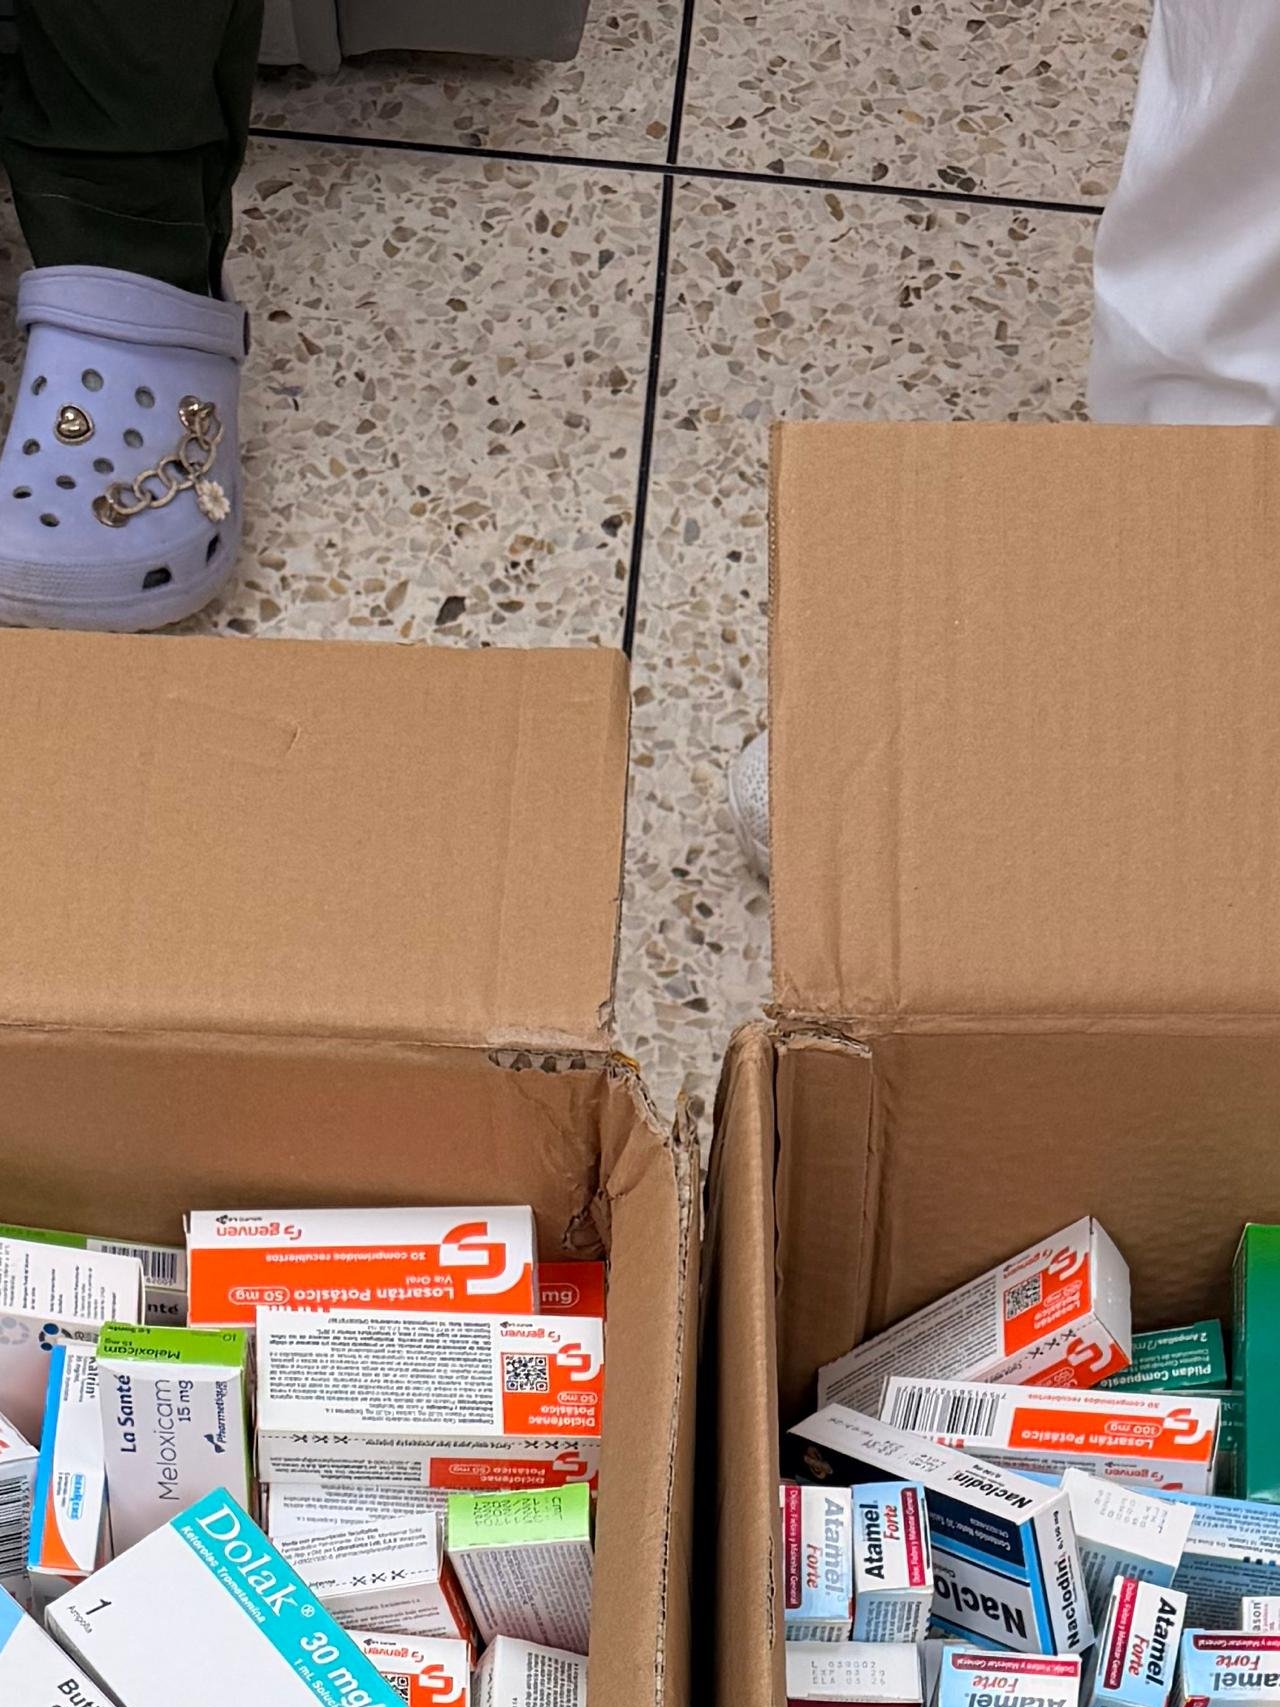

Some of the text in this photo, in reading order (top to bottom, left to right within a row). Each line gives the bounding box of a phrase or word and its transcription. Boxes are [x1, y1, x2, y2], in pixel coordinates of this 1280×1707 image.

[216, 1223, 281, 1237] genven
[235, 1286, 454, 1303] Losartán Potásico 50 mg
[542, 1290, 573, 1305] mg
[1173, 1364, 1212, 1377] Plidan
[178, 1380, 193, 1423] 15 mg
[151, 1379, 179, 1501] Meloxicam
[528, 1416, 596, 1427] Diclofenac
[1021, 1430, 1154, 1449] Losartán Potásico
[945, 1470, 1033, 1510] Naclodin
[859, 1502, 885, 1580] Atamel
[884, 1504, 901, 1541] Forte
[806, 1543, 819, 1589] Forte
[933, 1574, 1028, 1639] Naclo
[1056, 1558, 1080, 1649] Naclodin
[300, 1631, 340, 1666] 30
[1128, 1634, 1150, 1676] Forte
[1149, 1597, 1177, 1687] Atamel
[1215, 1654, 1260, 1669] Forte
[973, 1675, 1019, 1693] Forte
